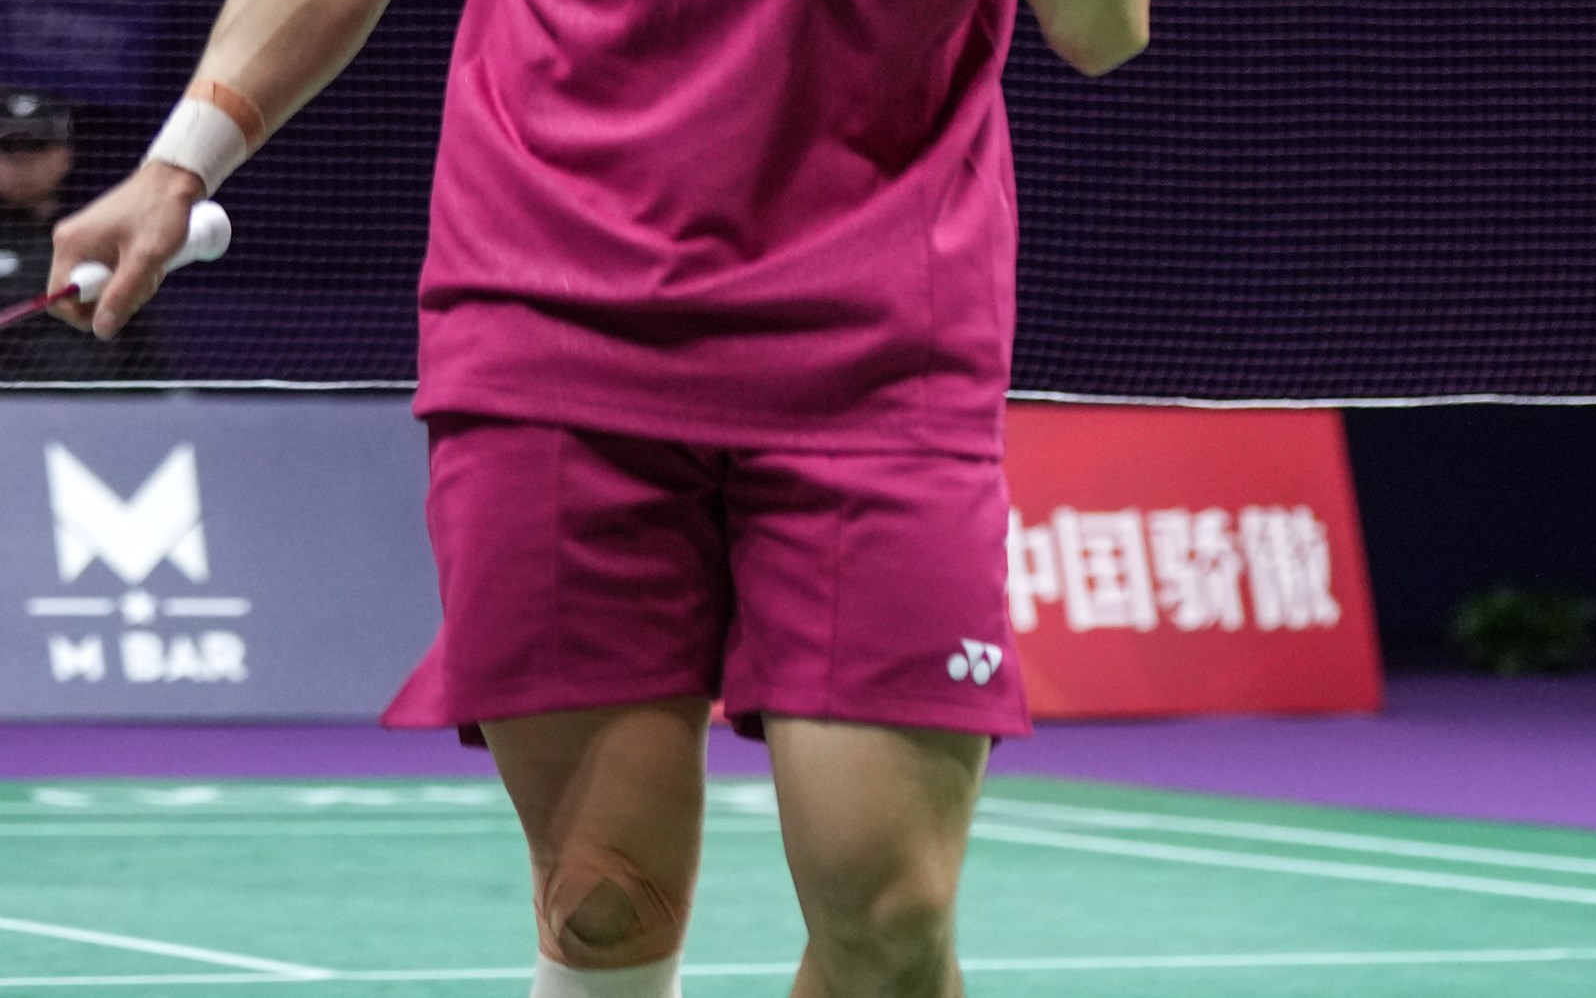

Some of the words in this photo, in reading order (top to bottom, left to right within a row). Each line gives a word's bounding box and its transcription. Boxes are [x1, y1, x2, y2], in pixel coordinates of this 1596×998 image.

[1006, 504, 1341, 634] 中国骄傲
[48, 634, 106, 683] M
[118, 630, 250, 684] BAR
